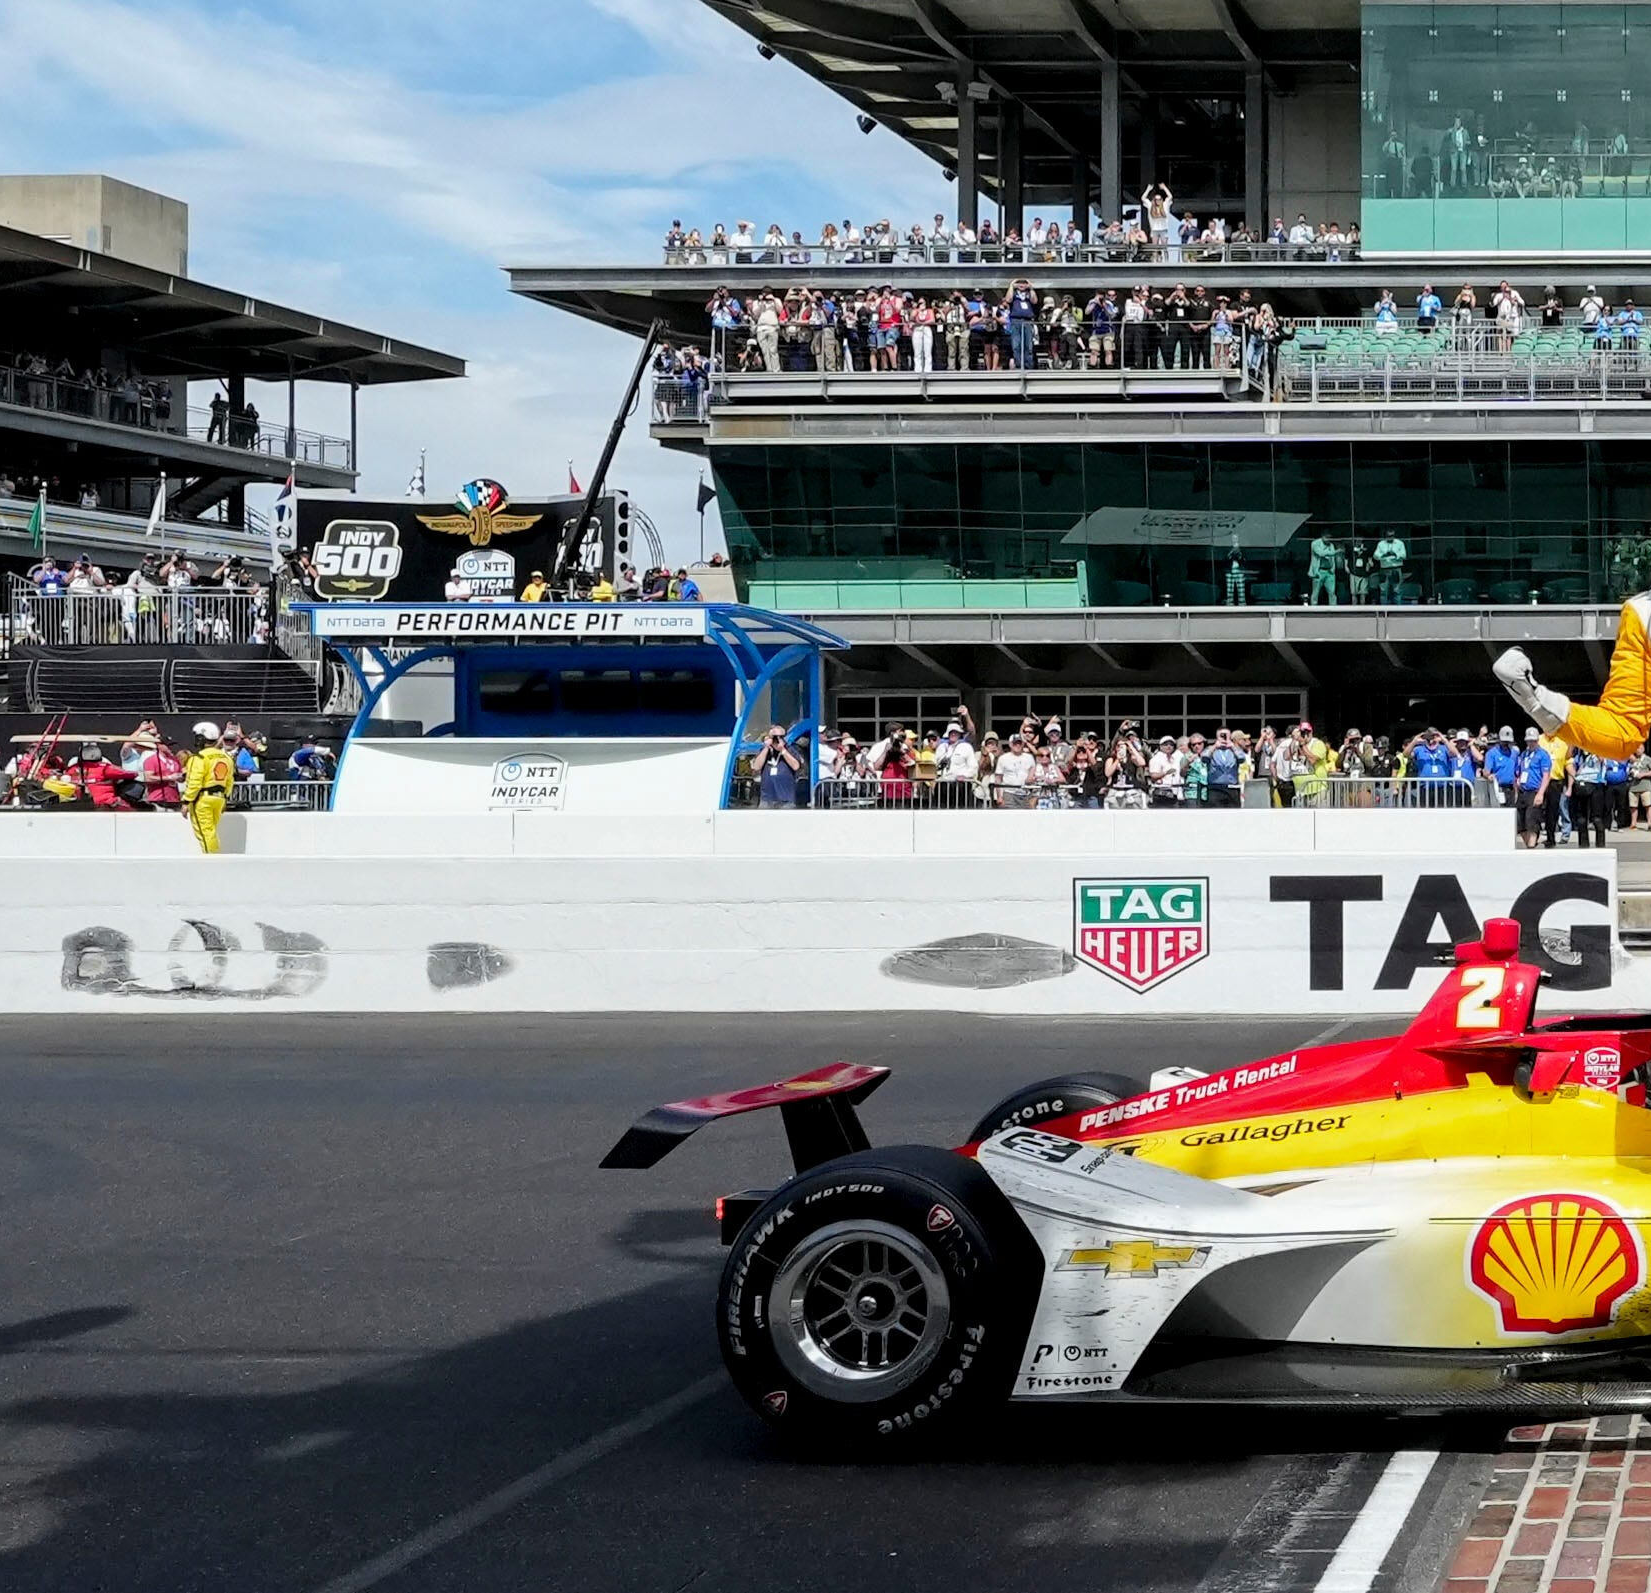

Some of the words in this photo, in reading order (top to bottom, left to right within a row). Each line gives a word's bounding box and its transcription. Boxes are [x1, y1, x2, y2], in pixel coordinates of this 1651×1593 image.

[339, 530, 385, 546] INDY
[318, 546, 399, 576] 500
[483, 562, 509, 571] NTT
[327, 617, 350, 627] NTT
[397, 613, 577, 631] PERFORMANCE
[585, 613, 624, 631] PIT
[634, 617, 659, 627] NTT
[525, 766, 558, 779] NTT
[491, 786, 559, 798] INDYCAR
[1087, 888, 1195, 920] TAG
[1084, 929, 1200, 983] HEUER
[1455, 966, 1507, 1029] 2
[1079, 1092, 1171, 1132] PENSKE
[1175, 1075, 1229, 1106] Truck
[1234, 1055, 1298, 1089] Rental
[1181, 1114, 1353, 1149] Gallagher
[727, 1202, 795, 1356] FIREHAWK
[1084, 1348, 1109, 1358] NTT
[877, 1324, 986, 1435] Firestone
[1026, 1375, 1113, 1389] Firestone
